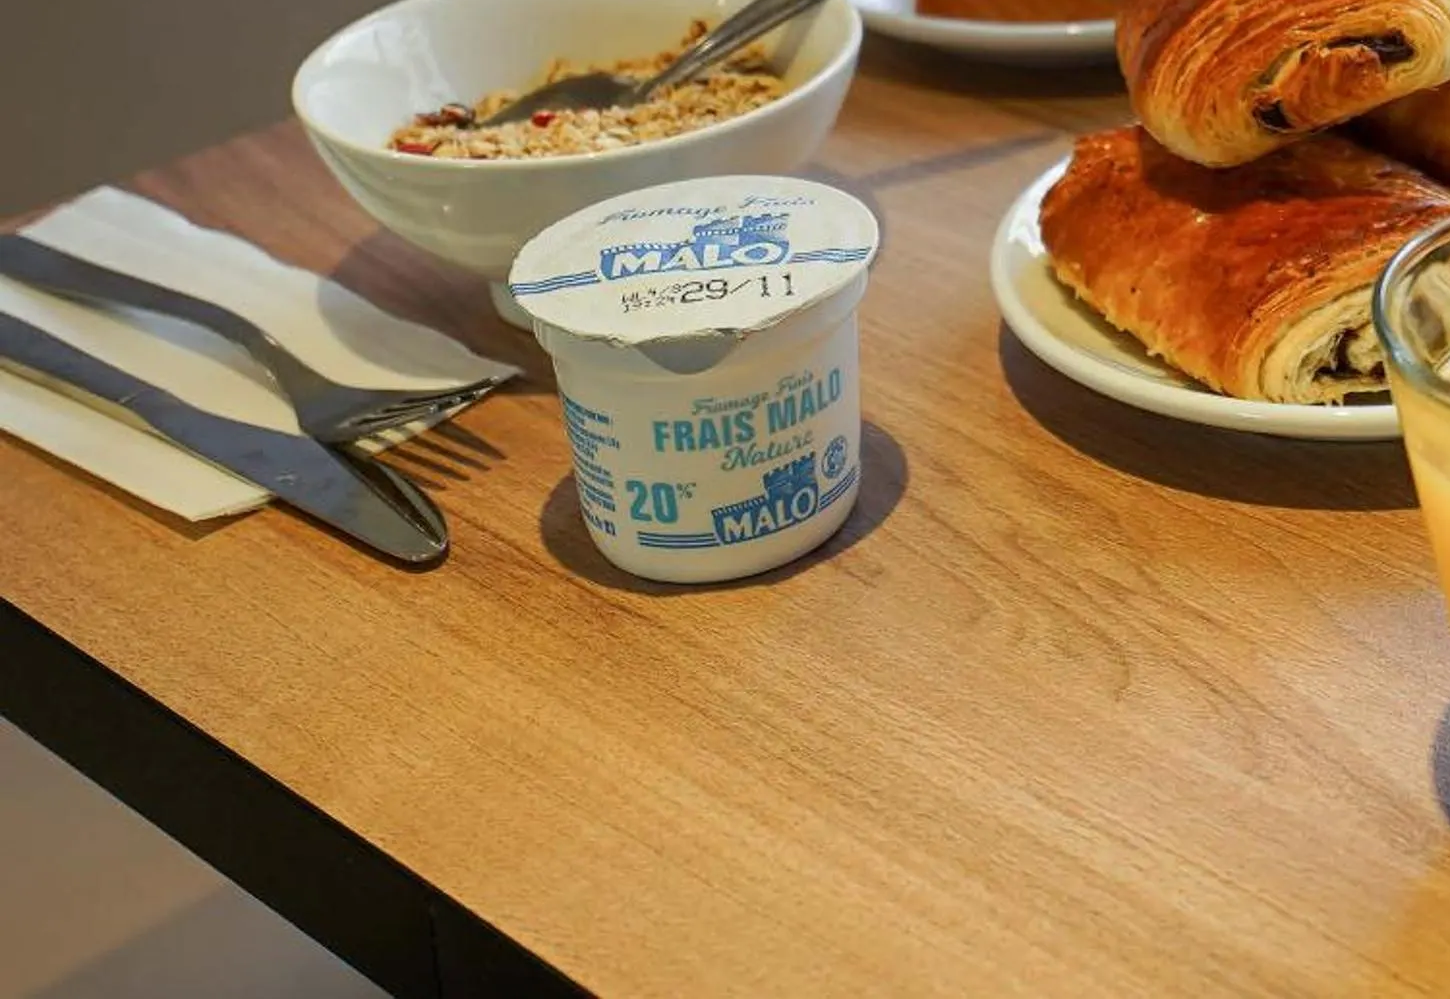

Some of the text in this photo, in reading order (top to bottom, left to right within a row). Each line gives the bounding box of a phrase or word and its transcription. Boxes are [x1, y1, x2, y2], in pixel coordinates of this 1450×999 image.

[611, 242, 783, 277] MALO
[680, 271, 795, 304] 29/11
[652, 367, 842, 452] FRAIS MALO
[720, 431, 814, 472] Nature
[722, 485, 817, 543] MALO
